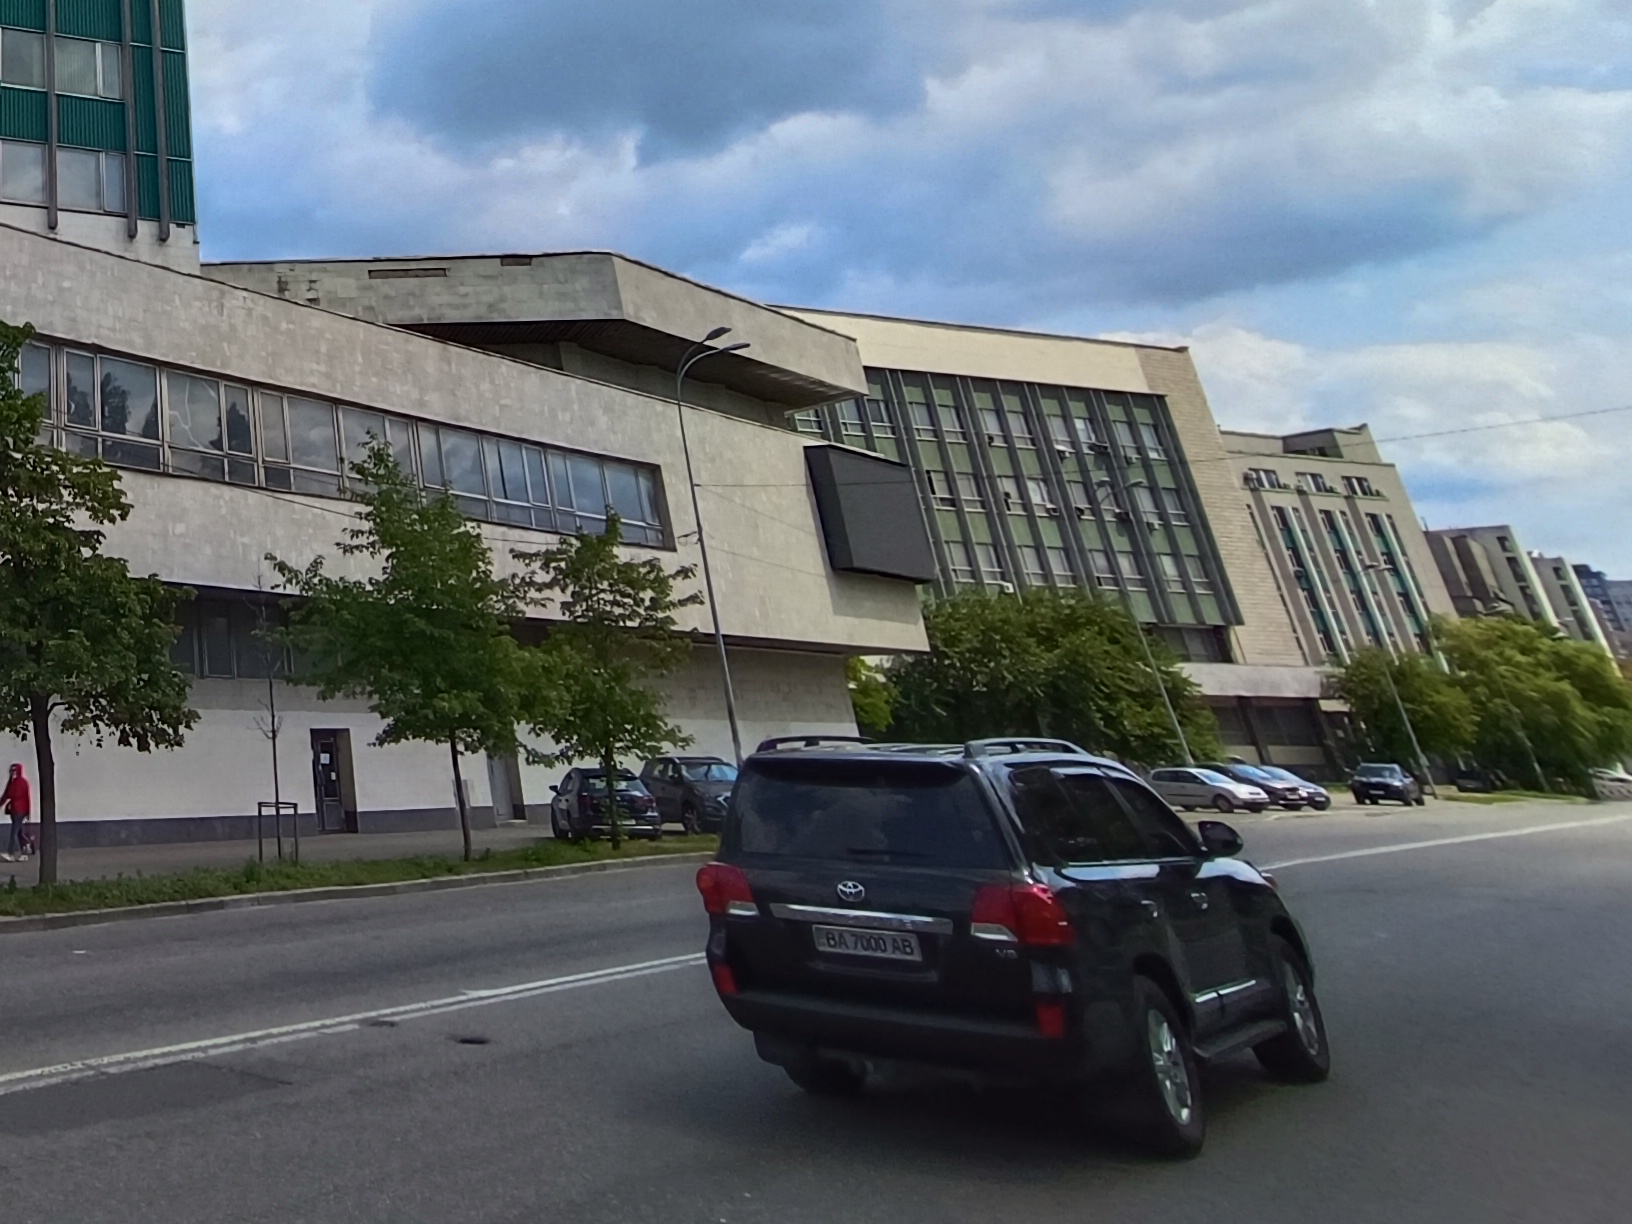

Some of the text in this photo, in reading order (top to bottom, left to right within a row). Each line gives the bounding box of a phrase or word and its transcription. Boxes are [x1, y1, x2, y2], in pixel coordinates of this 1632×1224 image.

[825, 932, 915, 956] BA 7000 AB
